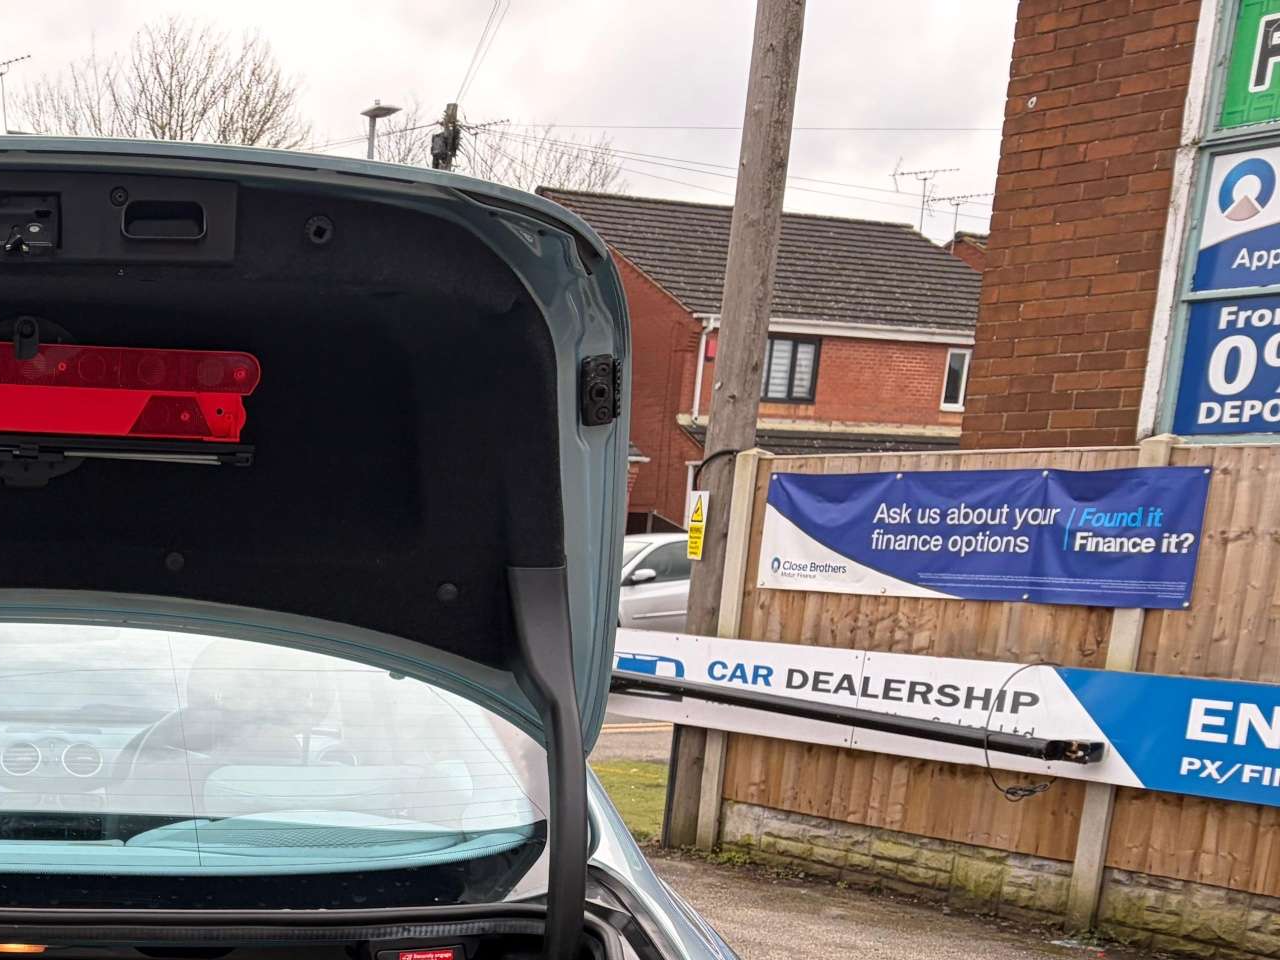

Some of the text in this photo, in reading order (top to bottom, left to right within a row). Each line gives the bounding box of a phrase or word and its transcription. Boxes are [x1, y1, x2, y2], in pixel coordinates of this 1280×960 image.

[873, 502, 1061, 530] Ask us about your
[1078, 506, 1165, 528] Found it
[871, 529, 1030, 558] finance options
[1073, 531, 1196, 554] Finance it?
[782, 560, 848, 574] Close Brothers
[707, 660, 1041, 715] CAR DEALERSHIP
